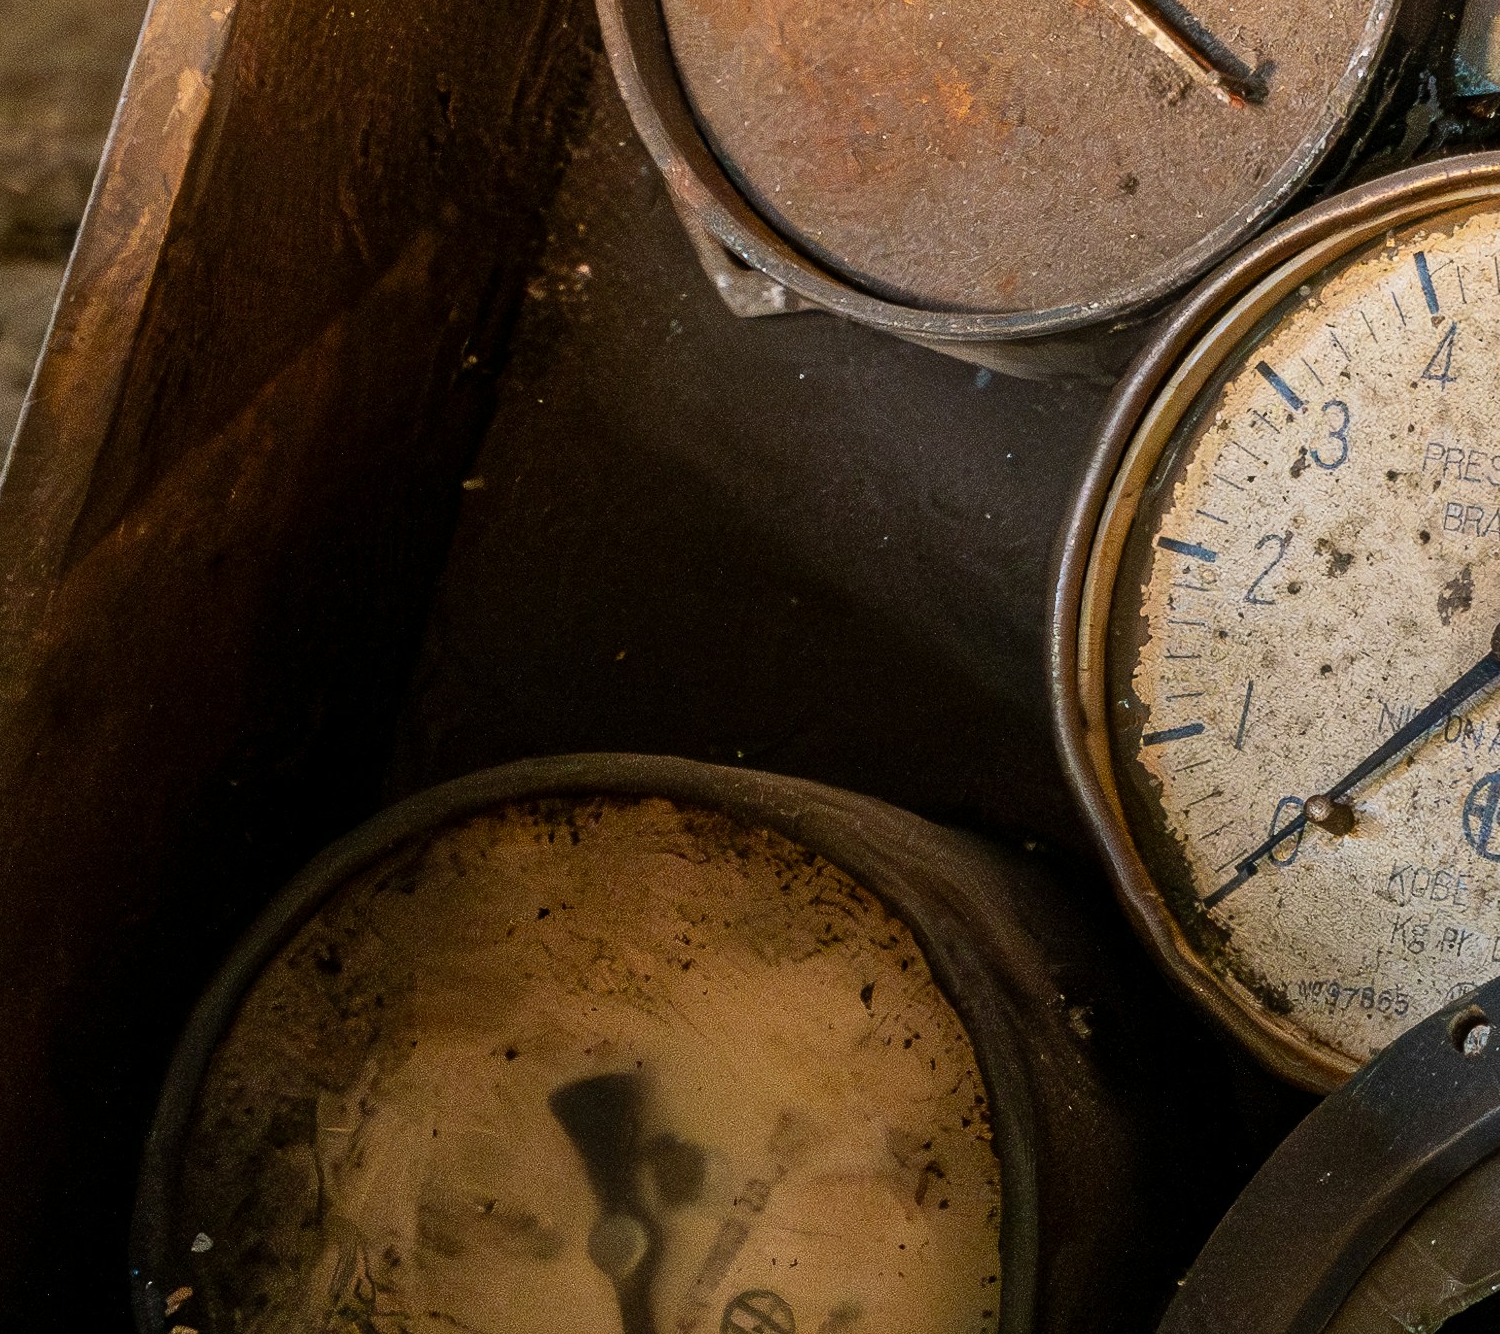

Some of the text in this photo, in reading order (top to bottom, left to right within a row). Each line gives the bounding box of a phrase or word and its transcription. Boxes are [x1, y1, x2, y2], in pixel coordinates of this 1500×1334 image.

[1422, 321, 1457, 391] 4
[1309, 399, 1349, 468] 3
[1244, 531, 1294, 605] 2
[1235, 680, 1253, 750] 1
[1270, 796, 1304, 867] 0
